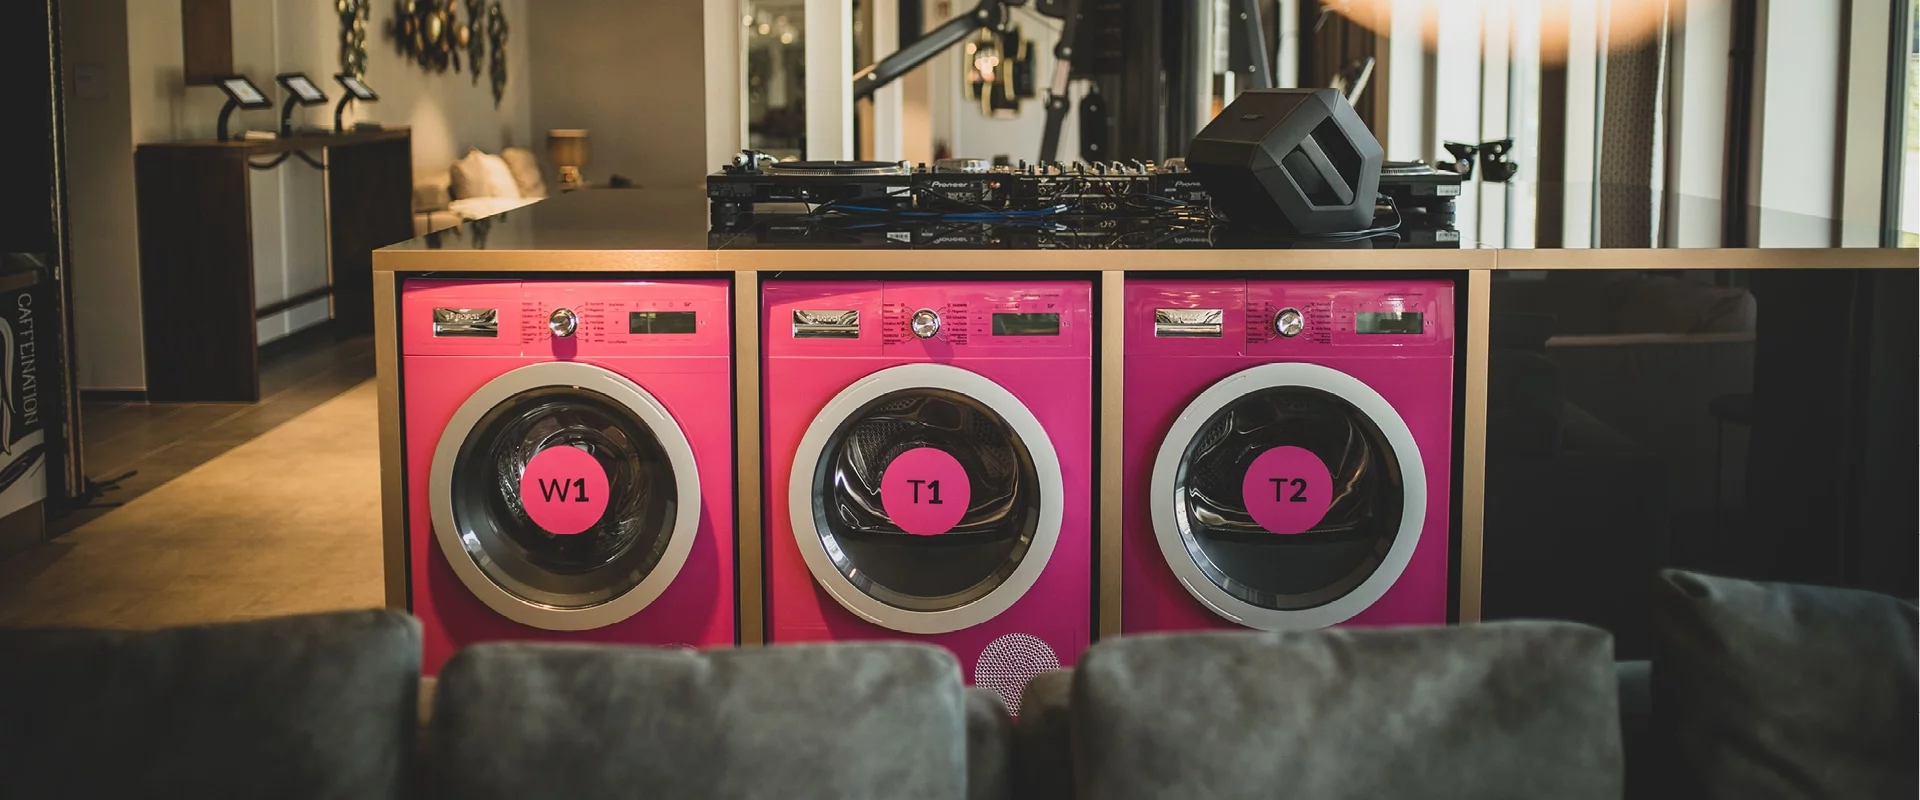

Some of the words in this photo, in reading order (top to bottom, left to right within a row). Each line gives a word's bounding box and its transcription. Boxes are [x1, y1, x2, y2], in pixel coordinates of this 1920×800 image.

[17, 293, 38, 426] CAFFEINATION
[538, 478, 589, 502] W1
[906, 480, 943, 504] T1
[1269, 478, 1307, 502] T2
